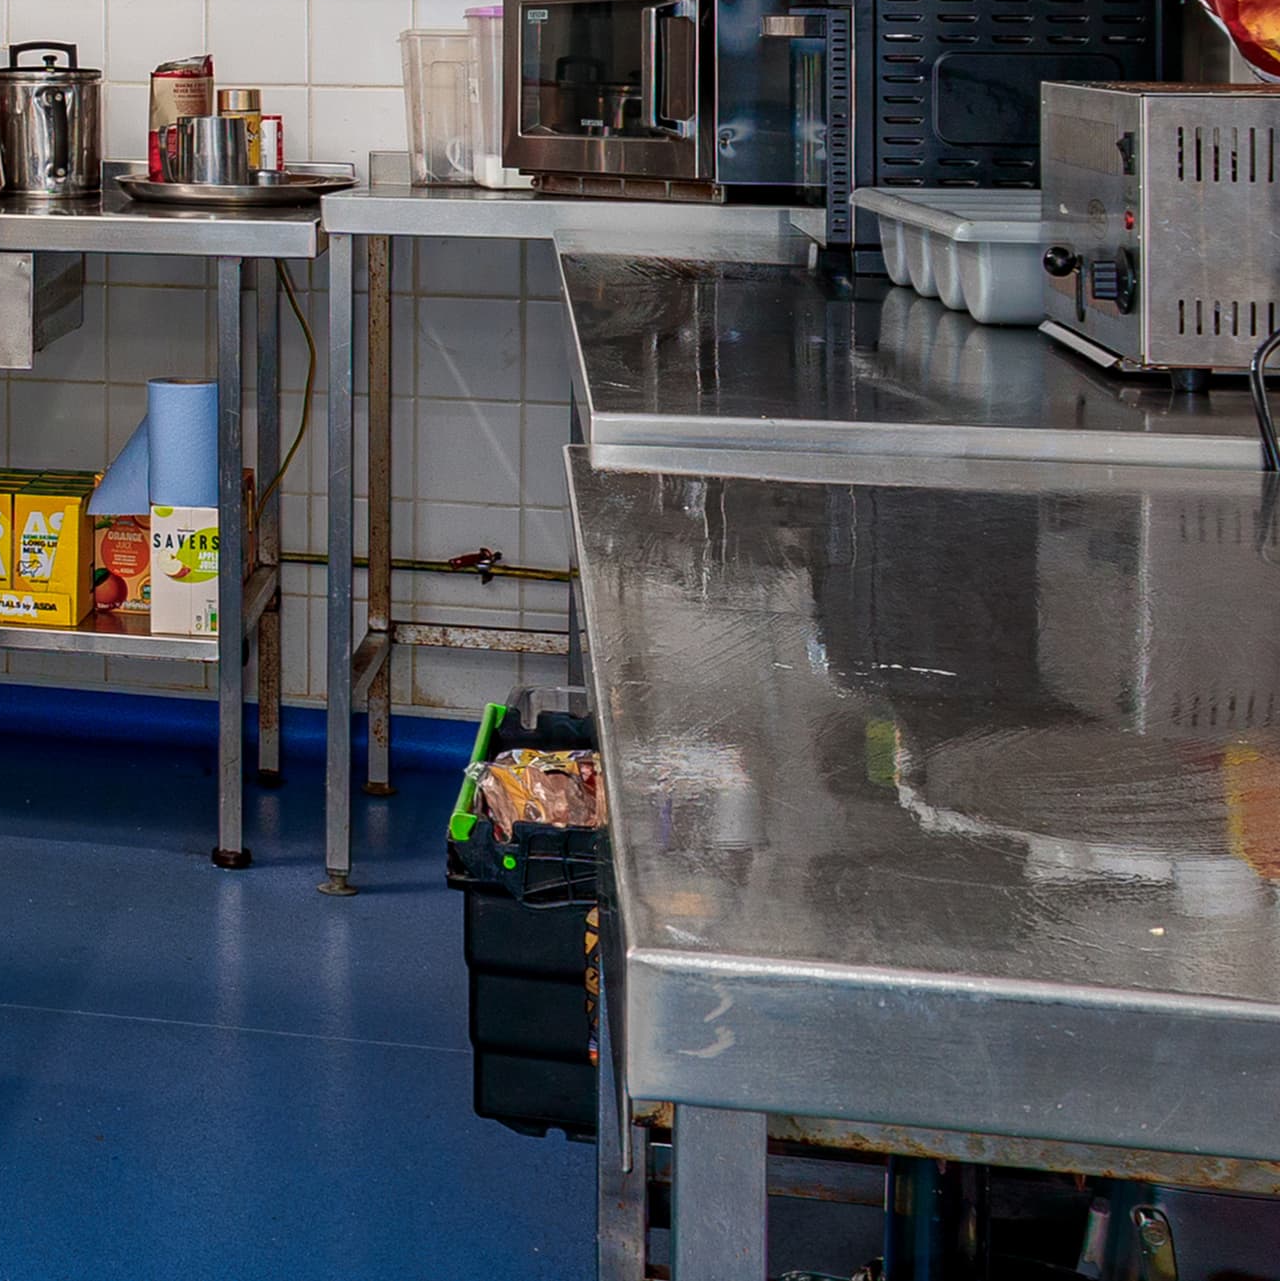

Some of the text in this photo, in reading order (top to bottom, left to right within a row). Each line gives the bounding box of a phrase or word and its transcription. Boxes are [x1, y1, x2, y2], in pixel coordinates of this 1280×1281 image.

[107, 530, 143, 542] ORANGE
[23, 540, 45, 548] LONG
[153, 533, 220, 550] SAVERS
[33, 602, 57, 611] ASDA
